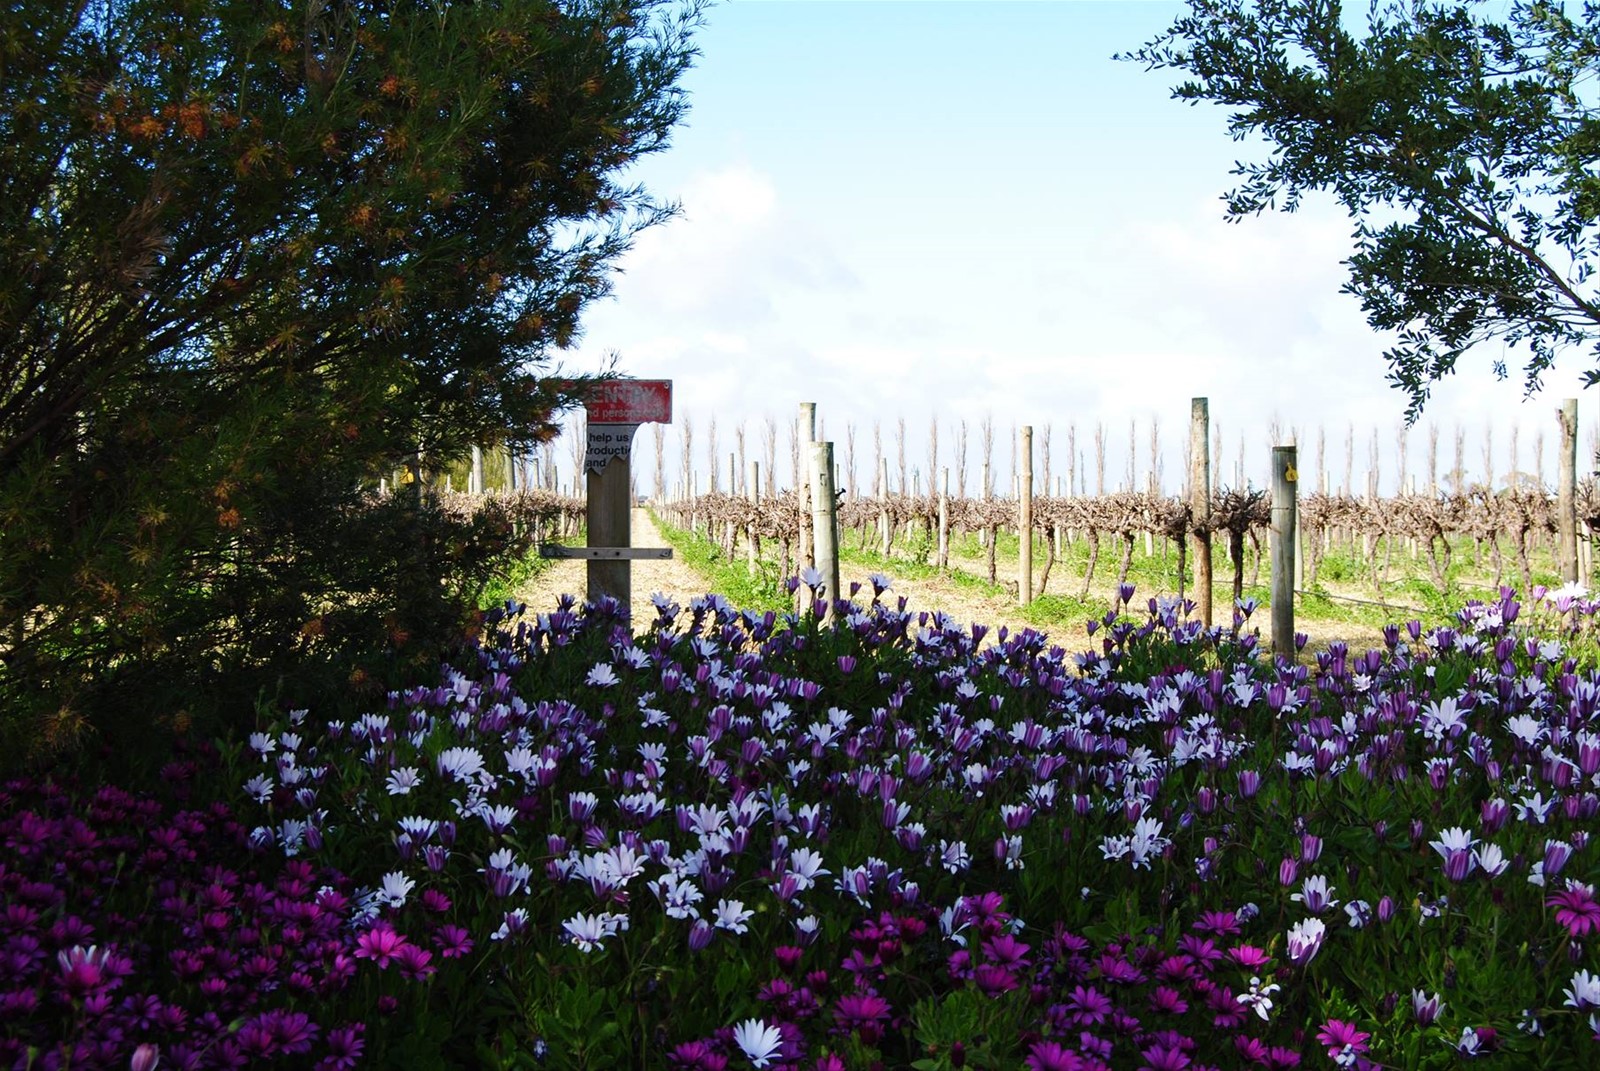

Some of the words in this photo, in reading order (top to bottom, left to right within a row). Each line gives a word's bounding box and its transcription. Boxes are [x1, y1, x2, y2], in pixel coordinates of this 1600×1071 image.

[589, 433, 612, 444] help
[616, 434, 629, 442] us
[586, 458, 606, 467] and
